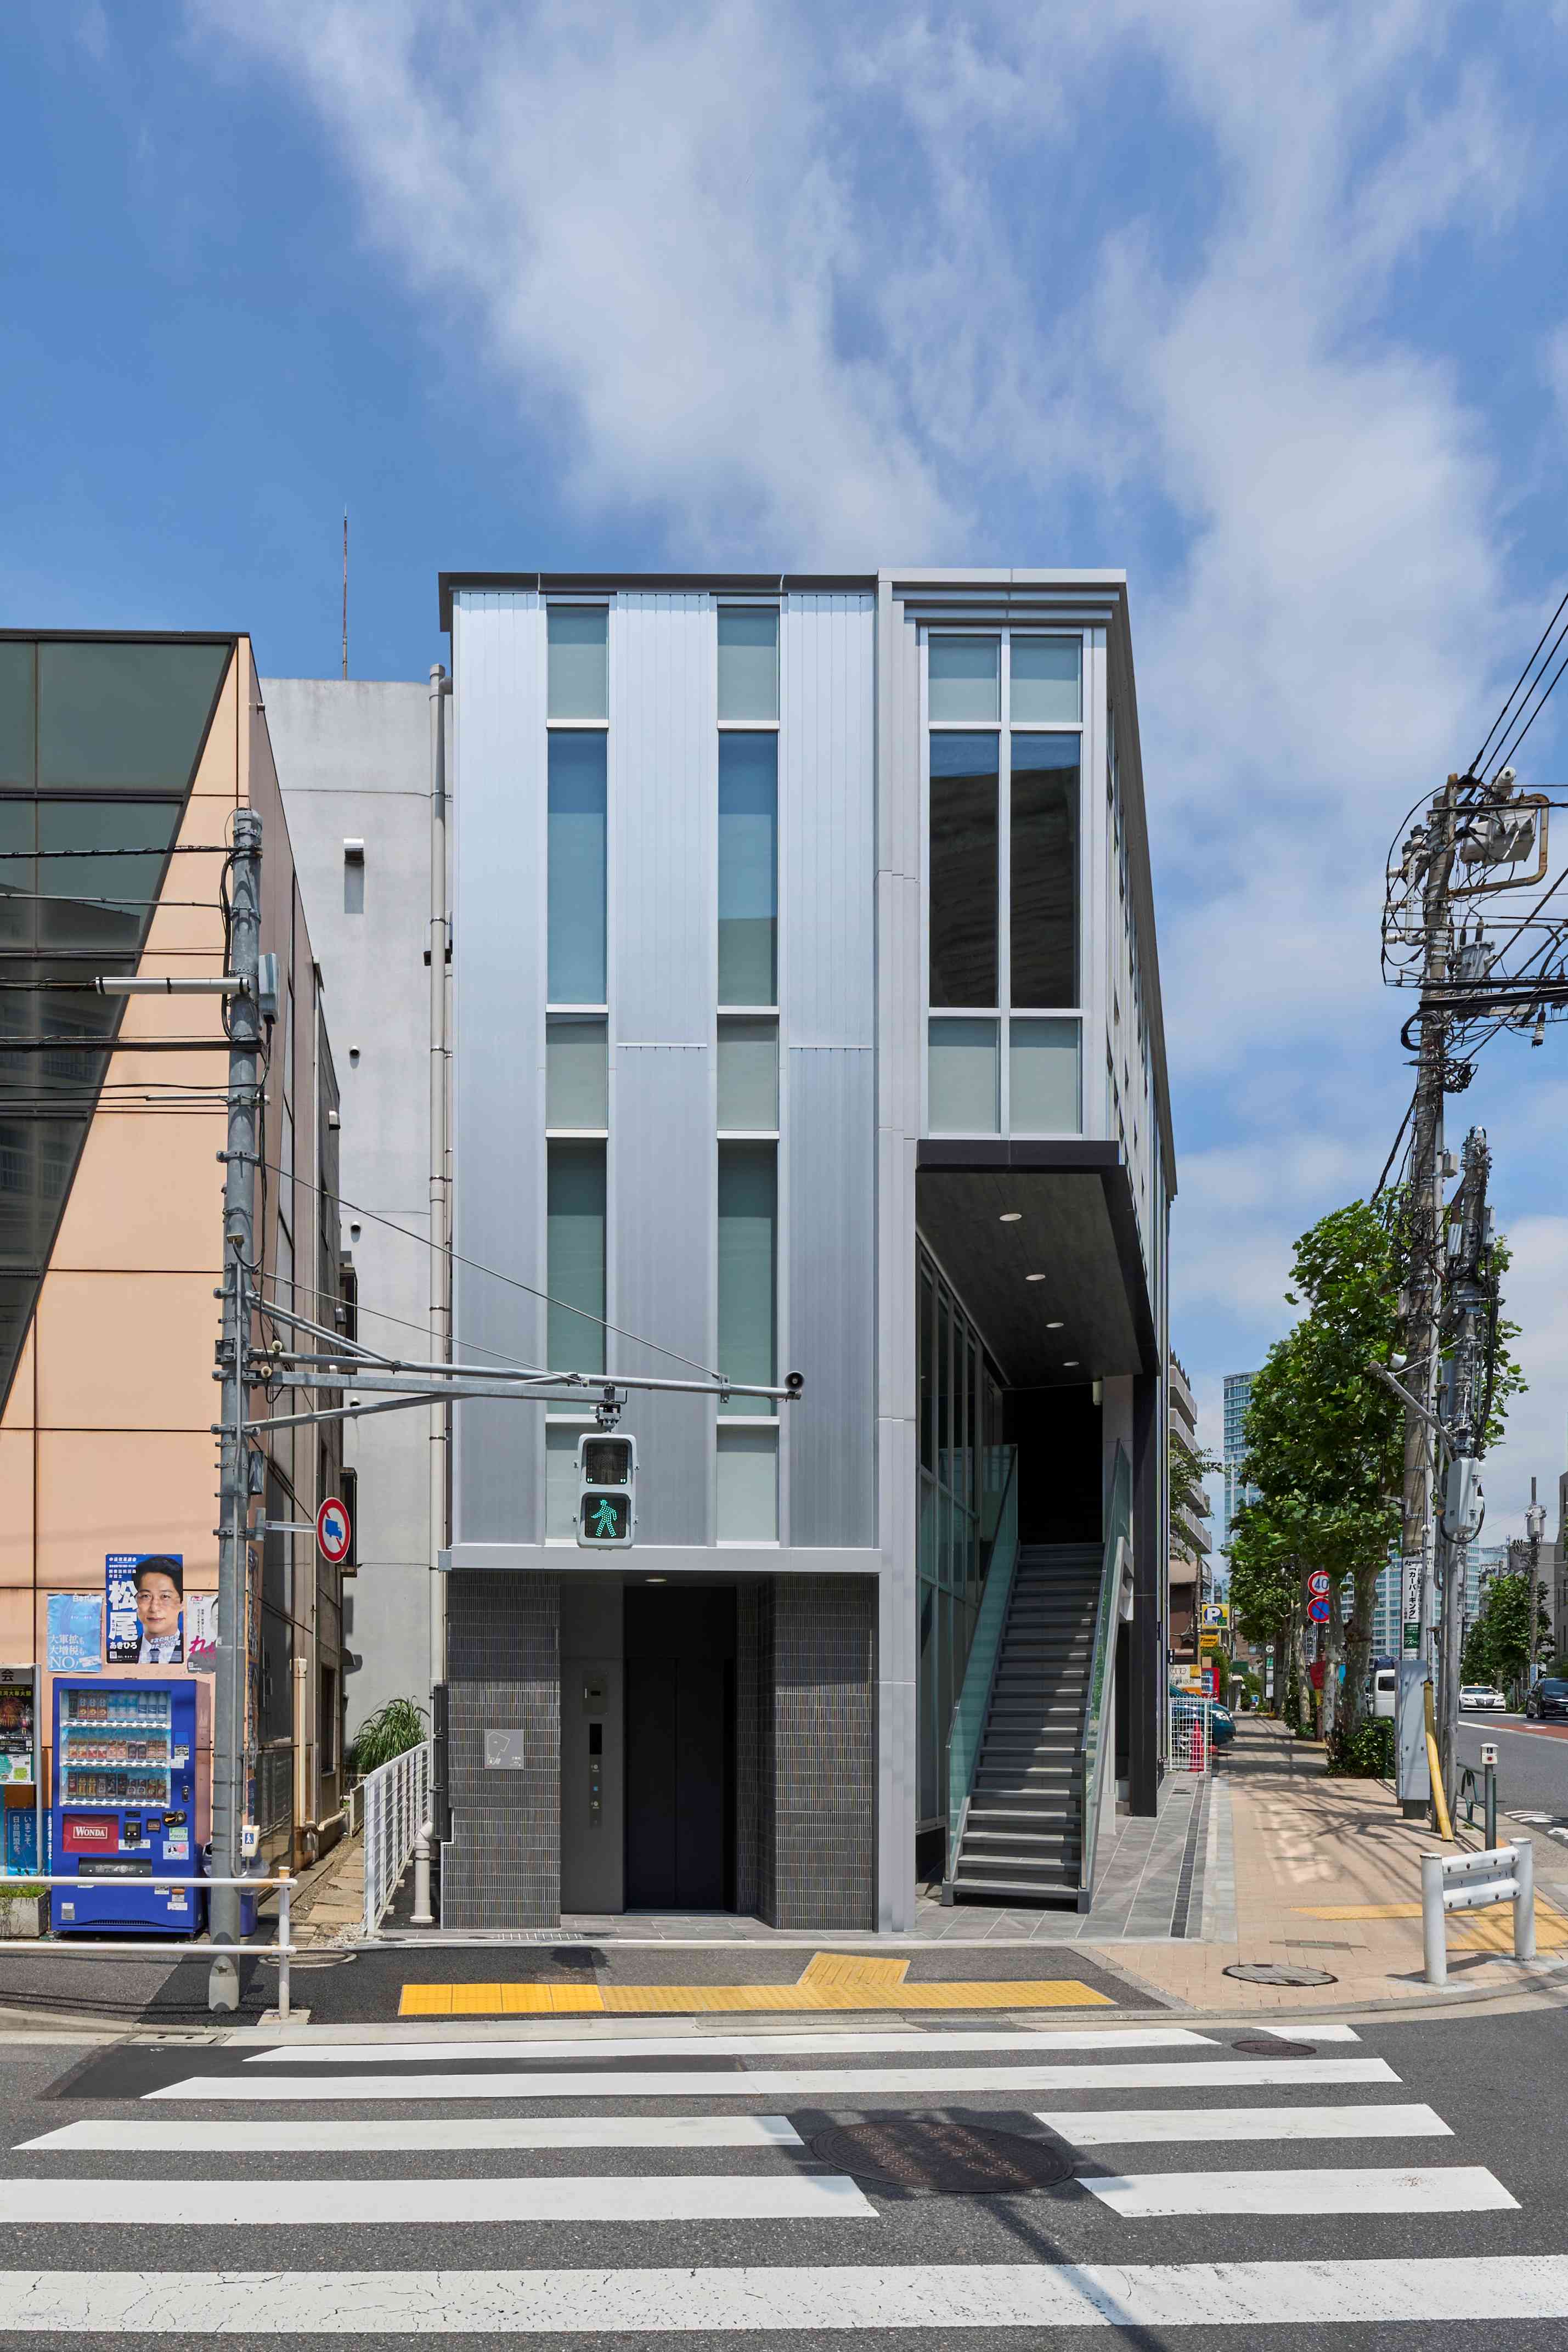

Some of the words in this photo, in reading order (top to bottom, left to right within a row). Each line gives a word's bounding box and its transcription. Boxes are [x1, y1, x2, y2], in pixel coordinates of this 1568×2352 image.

[1315, 1578, 1328, 1589] 40
[109, 1581, 138, 1641] 松尾
[1207, 1607, 1221, 1621] P
[49, 1634, 85, 1645] 大軍拡も
[49, 1645, 85, 1655] 大増税も
[109, 1642, 137, 1650] あきひろ
[76, 1828, 105, 1837] WONDA
